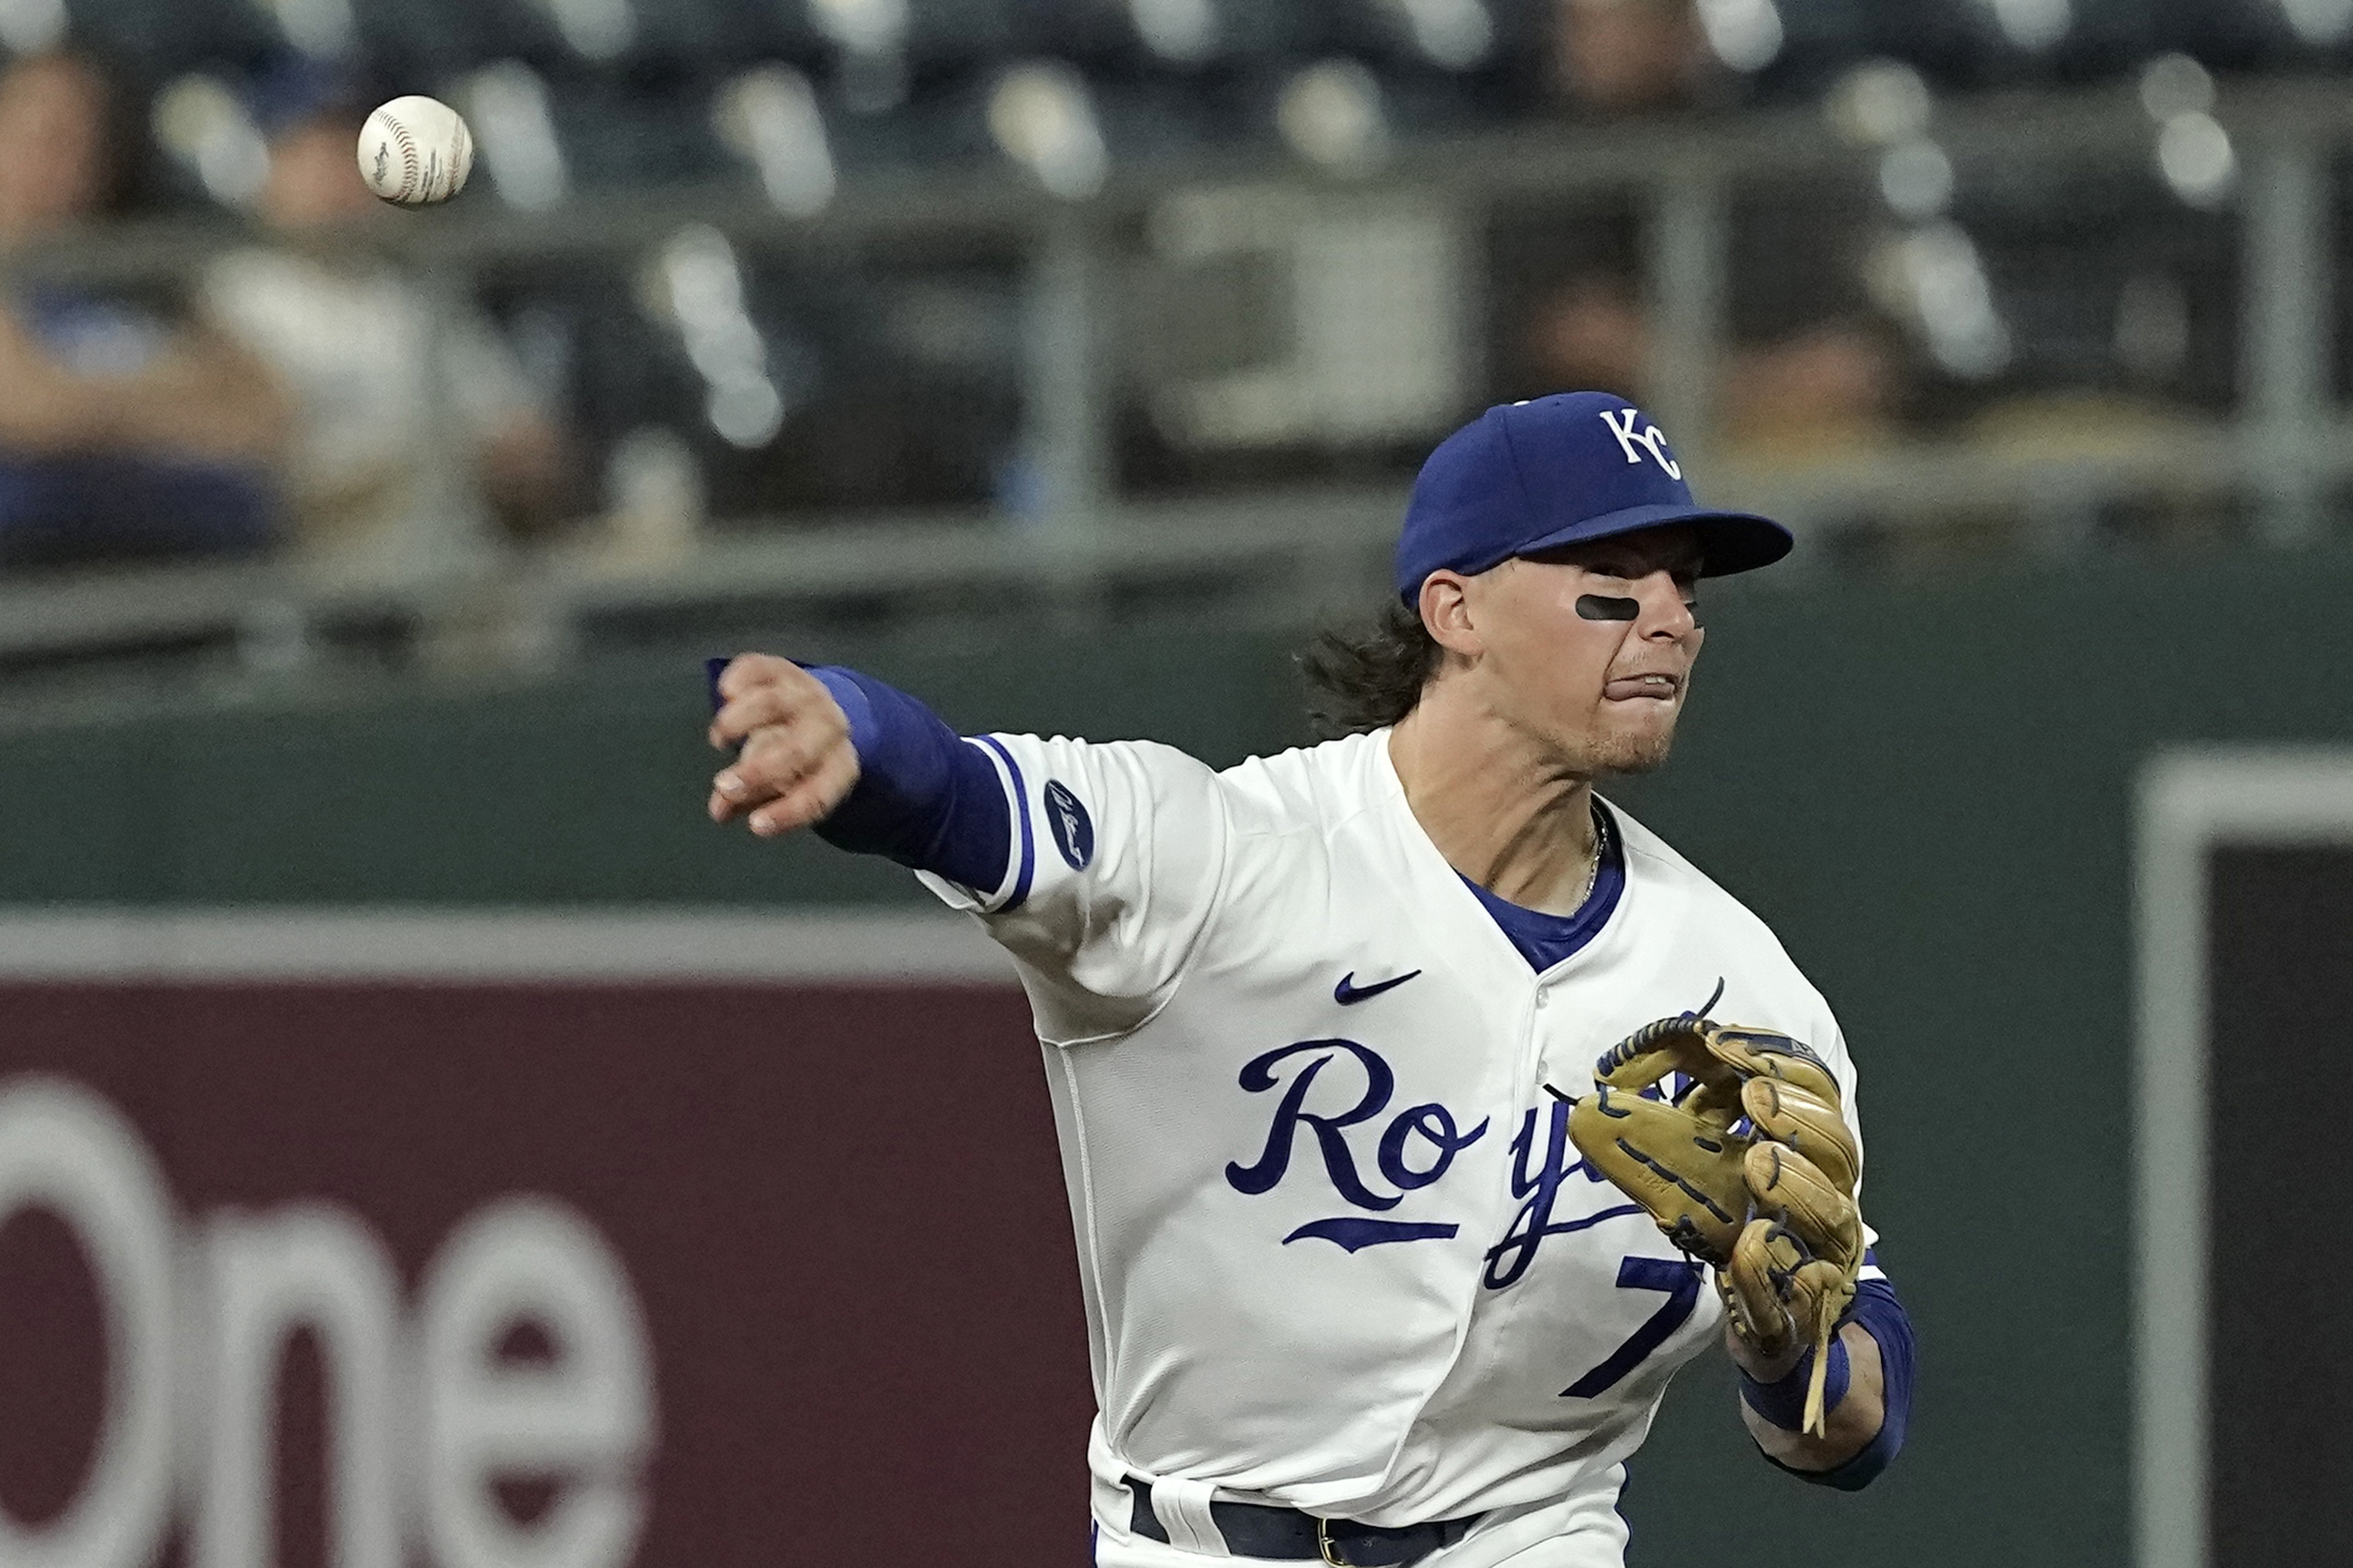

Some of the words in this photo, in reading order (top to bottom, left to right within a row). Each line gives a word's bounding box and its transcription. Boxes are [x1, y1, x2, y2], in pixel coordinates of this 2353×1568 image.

[1598, 407, 1683, 481] KC
[1225, 1010, 1752, 1287] Roy
[0, 1070, 658, 1568] One
[1557, 1255, 1705, 1399] 7
